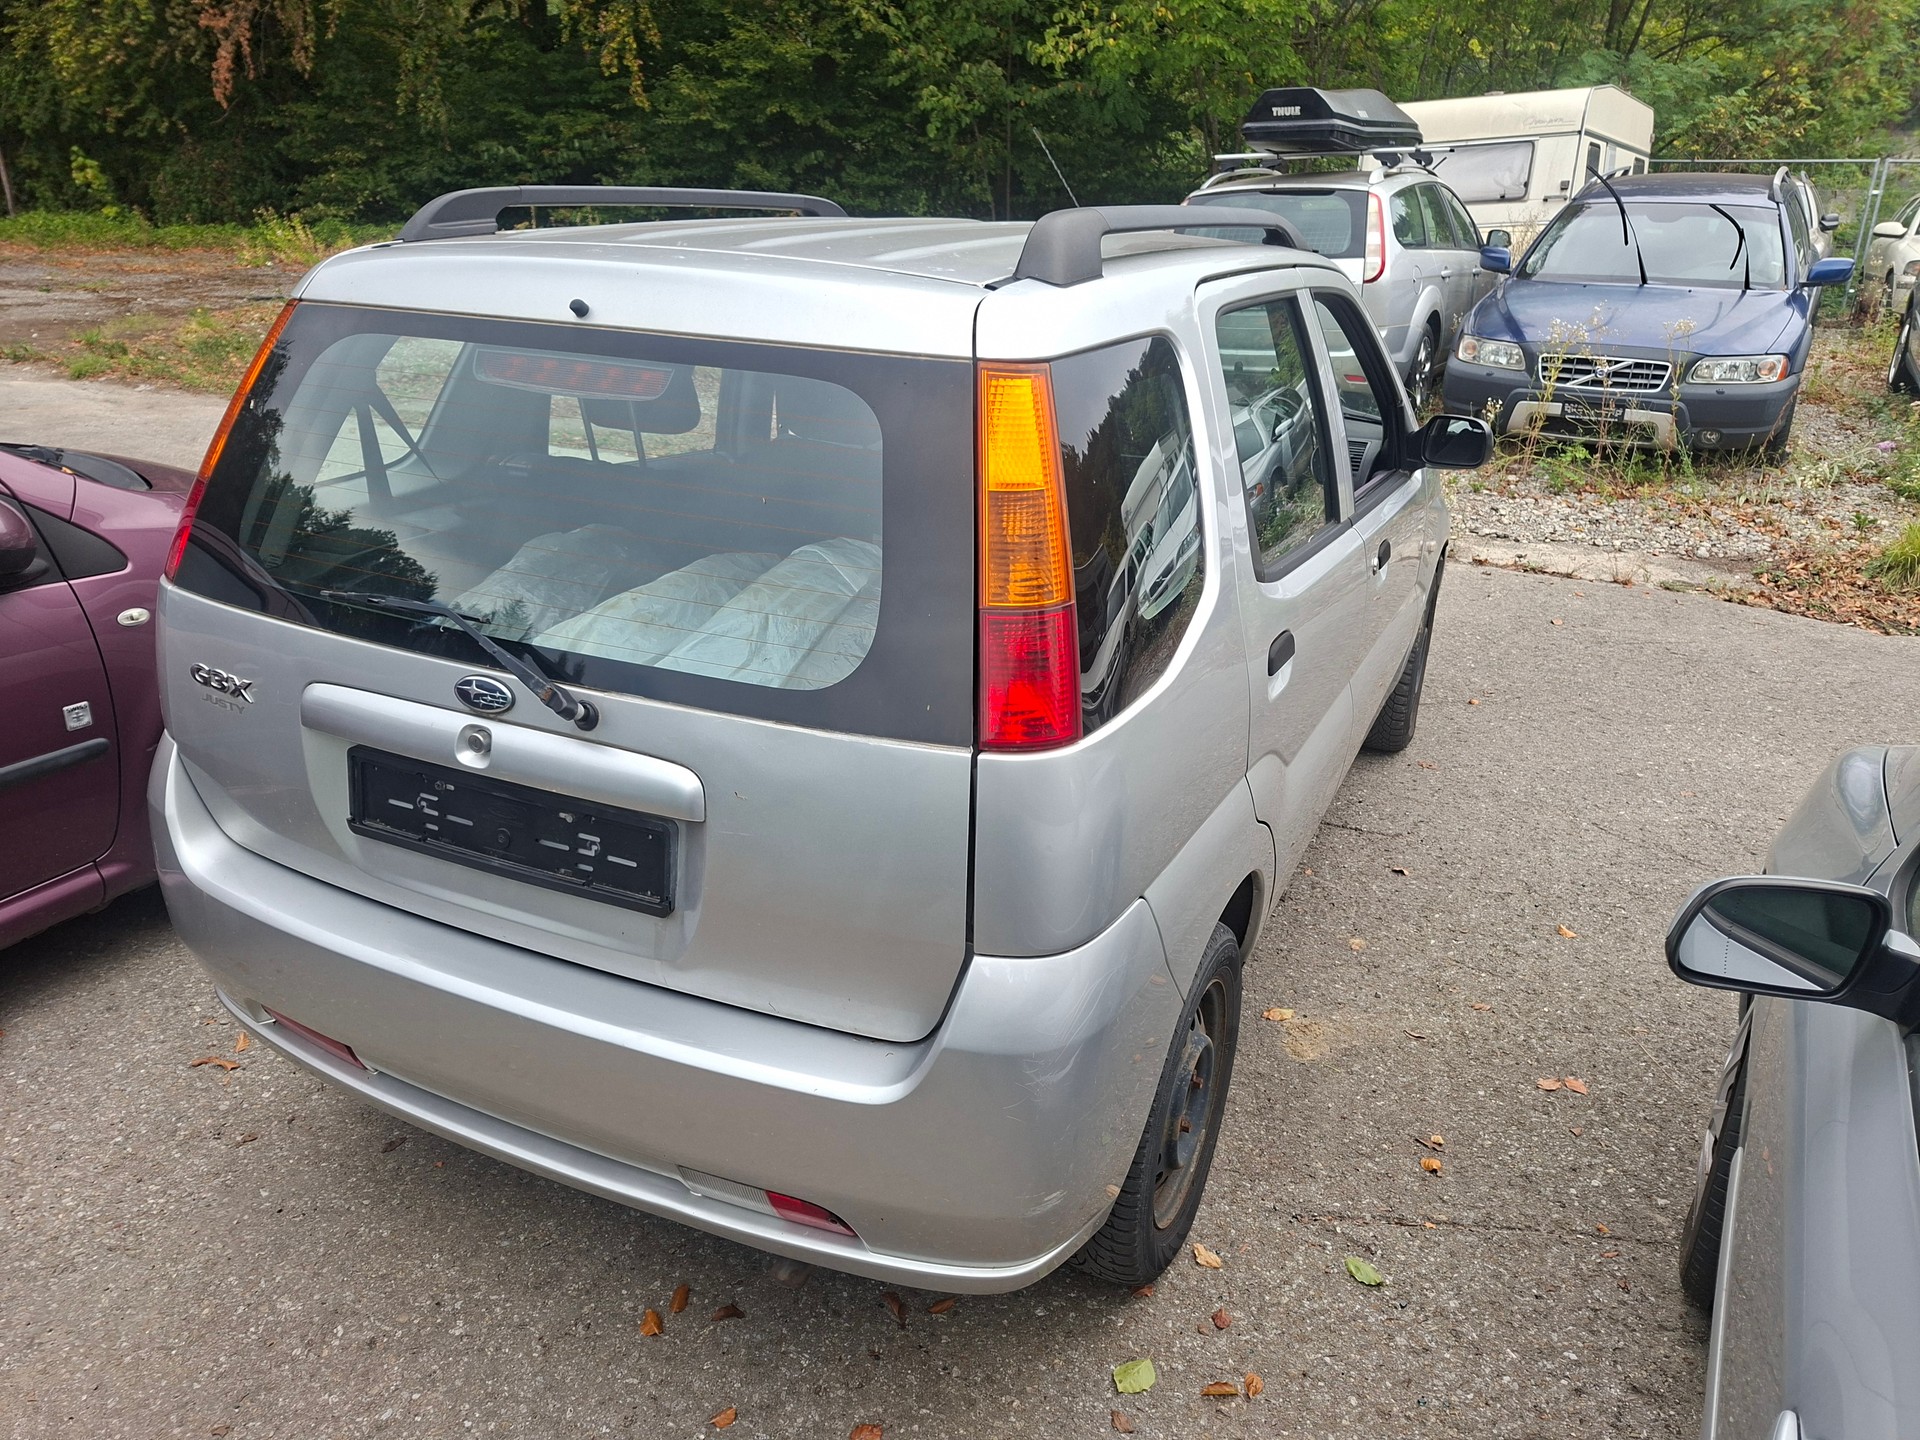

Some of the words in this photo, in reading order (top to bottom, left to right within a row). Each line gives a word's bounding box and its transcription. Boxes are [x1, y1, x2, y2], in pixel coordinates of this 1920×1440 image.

[1272, 106, 1301, 117] THULE
[190, 662, 254, 704] G3X
[202, 693, 245, 714] JUSTY
